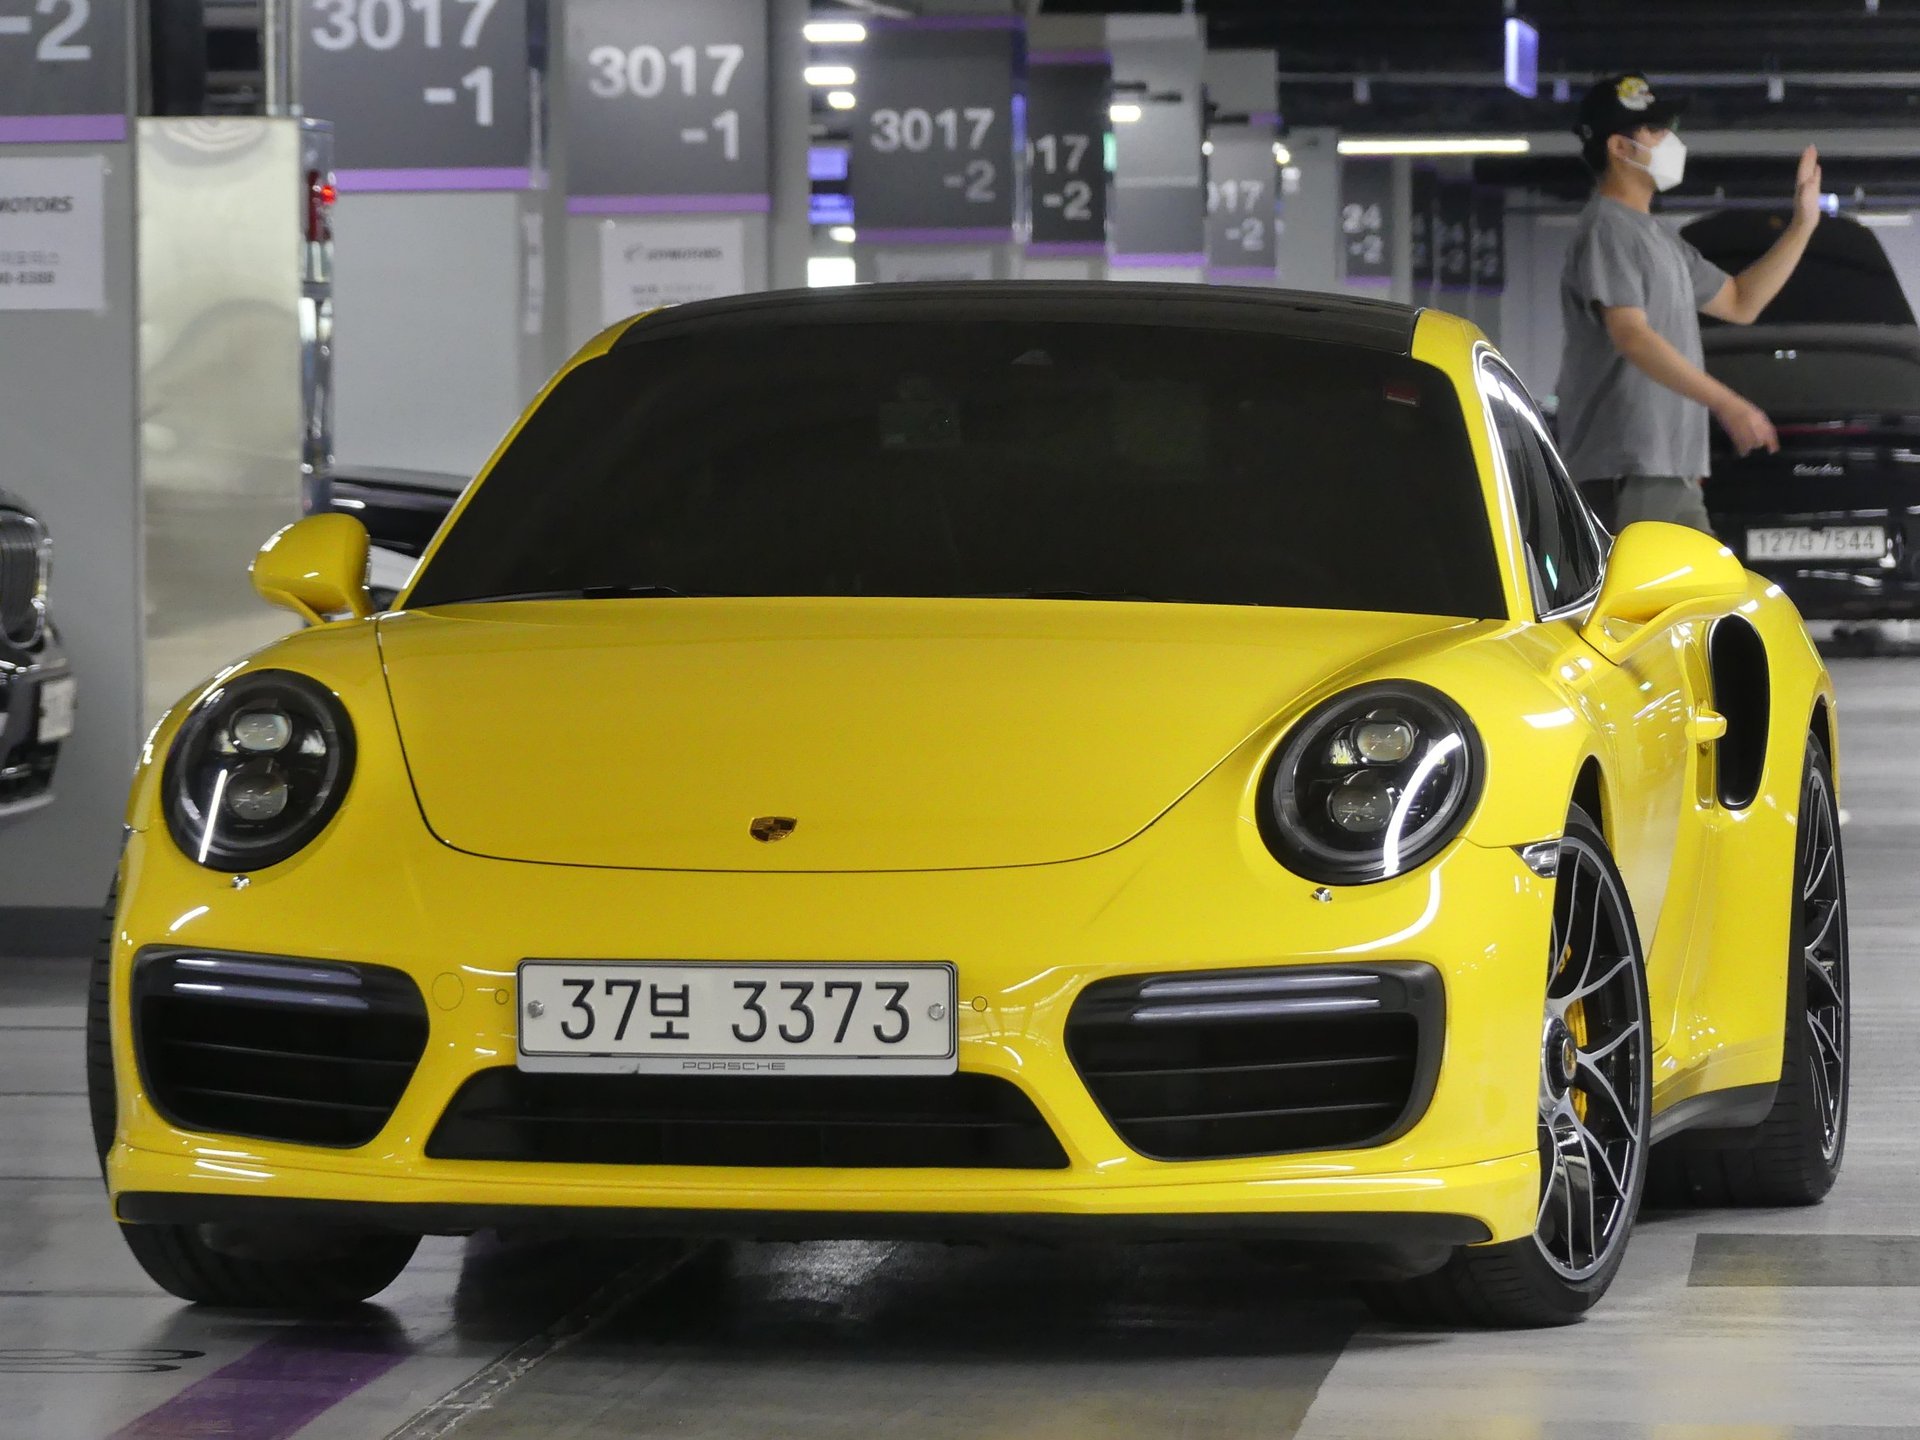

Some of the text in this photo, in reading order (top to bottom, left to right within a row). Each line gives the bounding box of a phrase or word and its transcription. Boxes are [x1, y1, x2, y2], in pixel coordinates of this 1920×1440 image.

[0, 0, 92, 60] -2
[311, 0, 498, 50] 3017
[588, 44, 745, 98] 3017
[423, 66, 494, 127] -1
[681, 110, 740, 161] -1
[870, 107, 996, 152] 3017
[1027, 133, 1090, 174] 17
[943, 160, 997, 202] -2
[1042, 180, 1093, 220] -2
[1225, 217, 1264, 251] -2
[560, 978, 910, 1044] 37보 3373
[682, 1061, 786, 1071] PORSCHE
